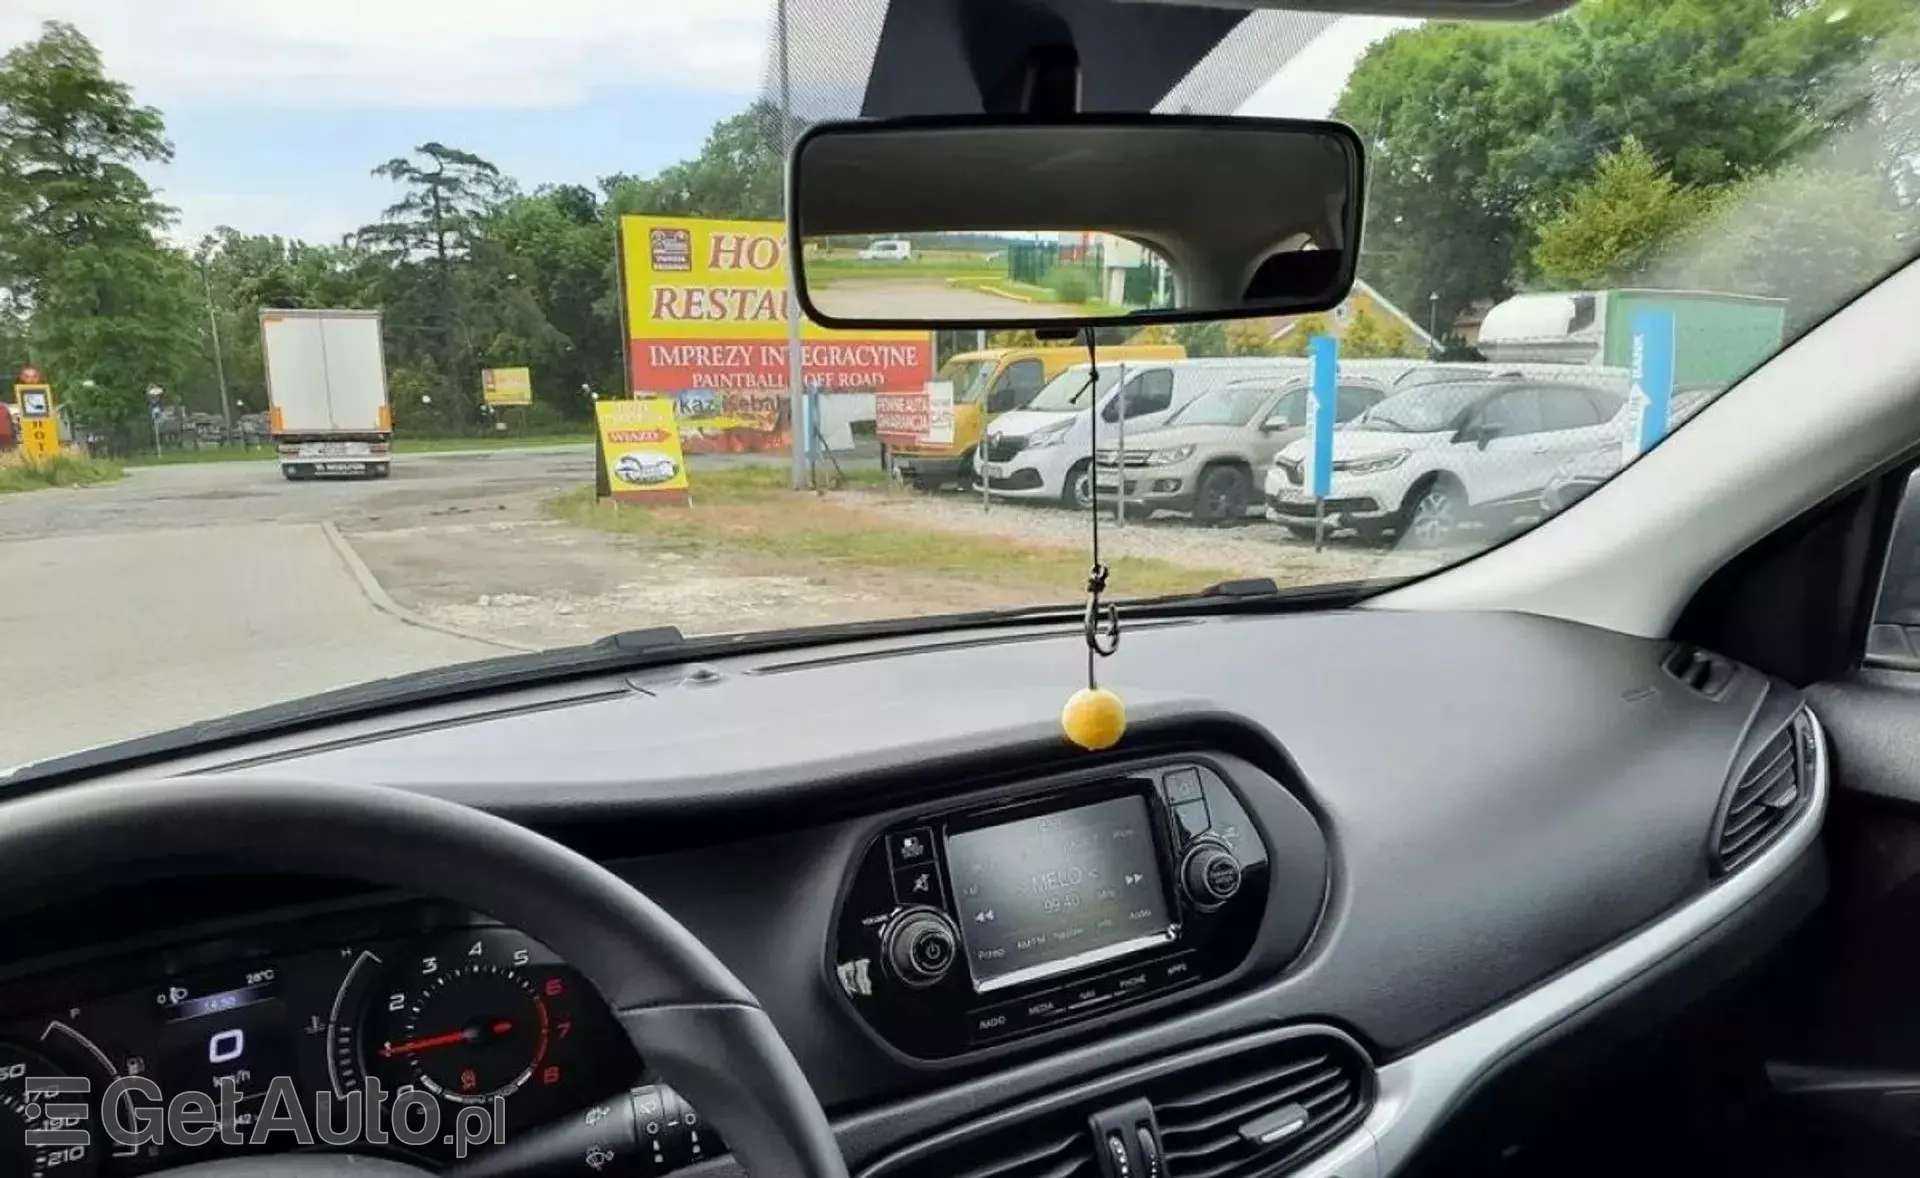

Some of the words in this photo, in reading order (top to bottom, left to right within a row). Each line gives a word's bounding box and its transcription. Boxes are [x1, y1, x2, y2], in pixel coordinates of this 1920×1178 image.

[708, 234, 787, 270] HO
[649, 346, 752, 367] IMPREZY
[760, 345, 918, 369] INEGRACYJNE
[691, 373, 784, 388] PAINTBALL
[803, 373, 836, 387] OFF
[468, 941, 483, 956] 4
[513, 949, 531, 967] 5
[422, 956, 439, 975] 3
[545, 978, 563, 996] 6
[388, 993, 406, 1012] 2
[979, 1014, 1007, 1031] RADIO
[1028, 1001, 1055, 1016] MEDIA
[1119, 973, 1147, 988] PHONE
[556, 1021, 573, 1040] 7
[209, 1028, 244, 1064] 0
[543, 1066, 560, 1084] 8
[48, 1145, 86, 1167] 210
